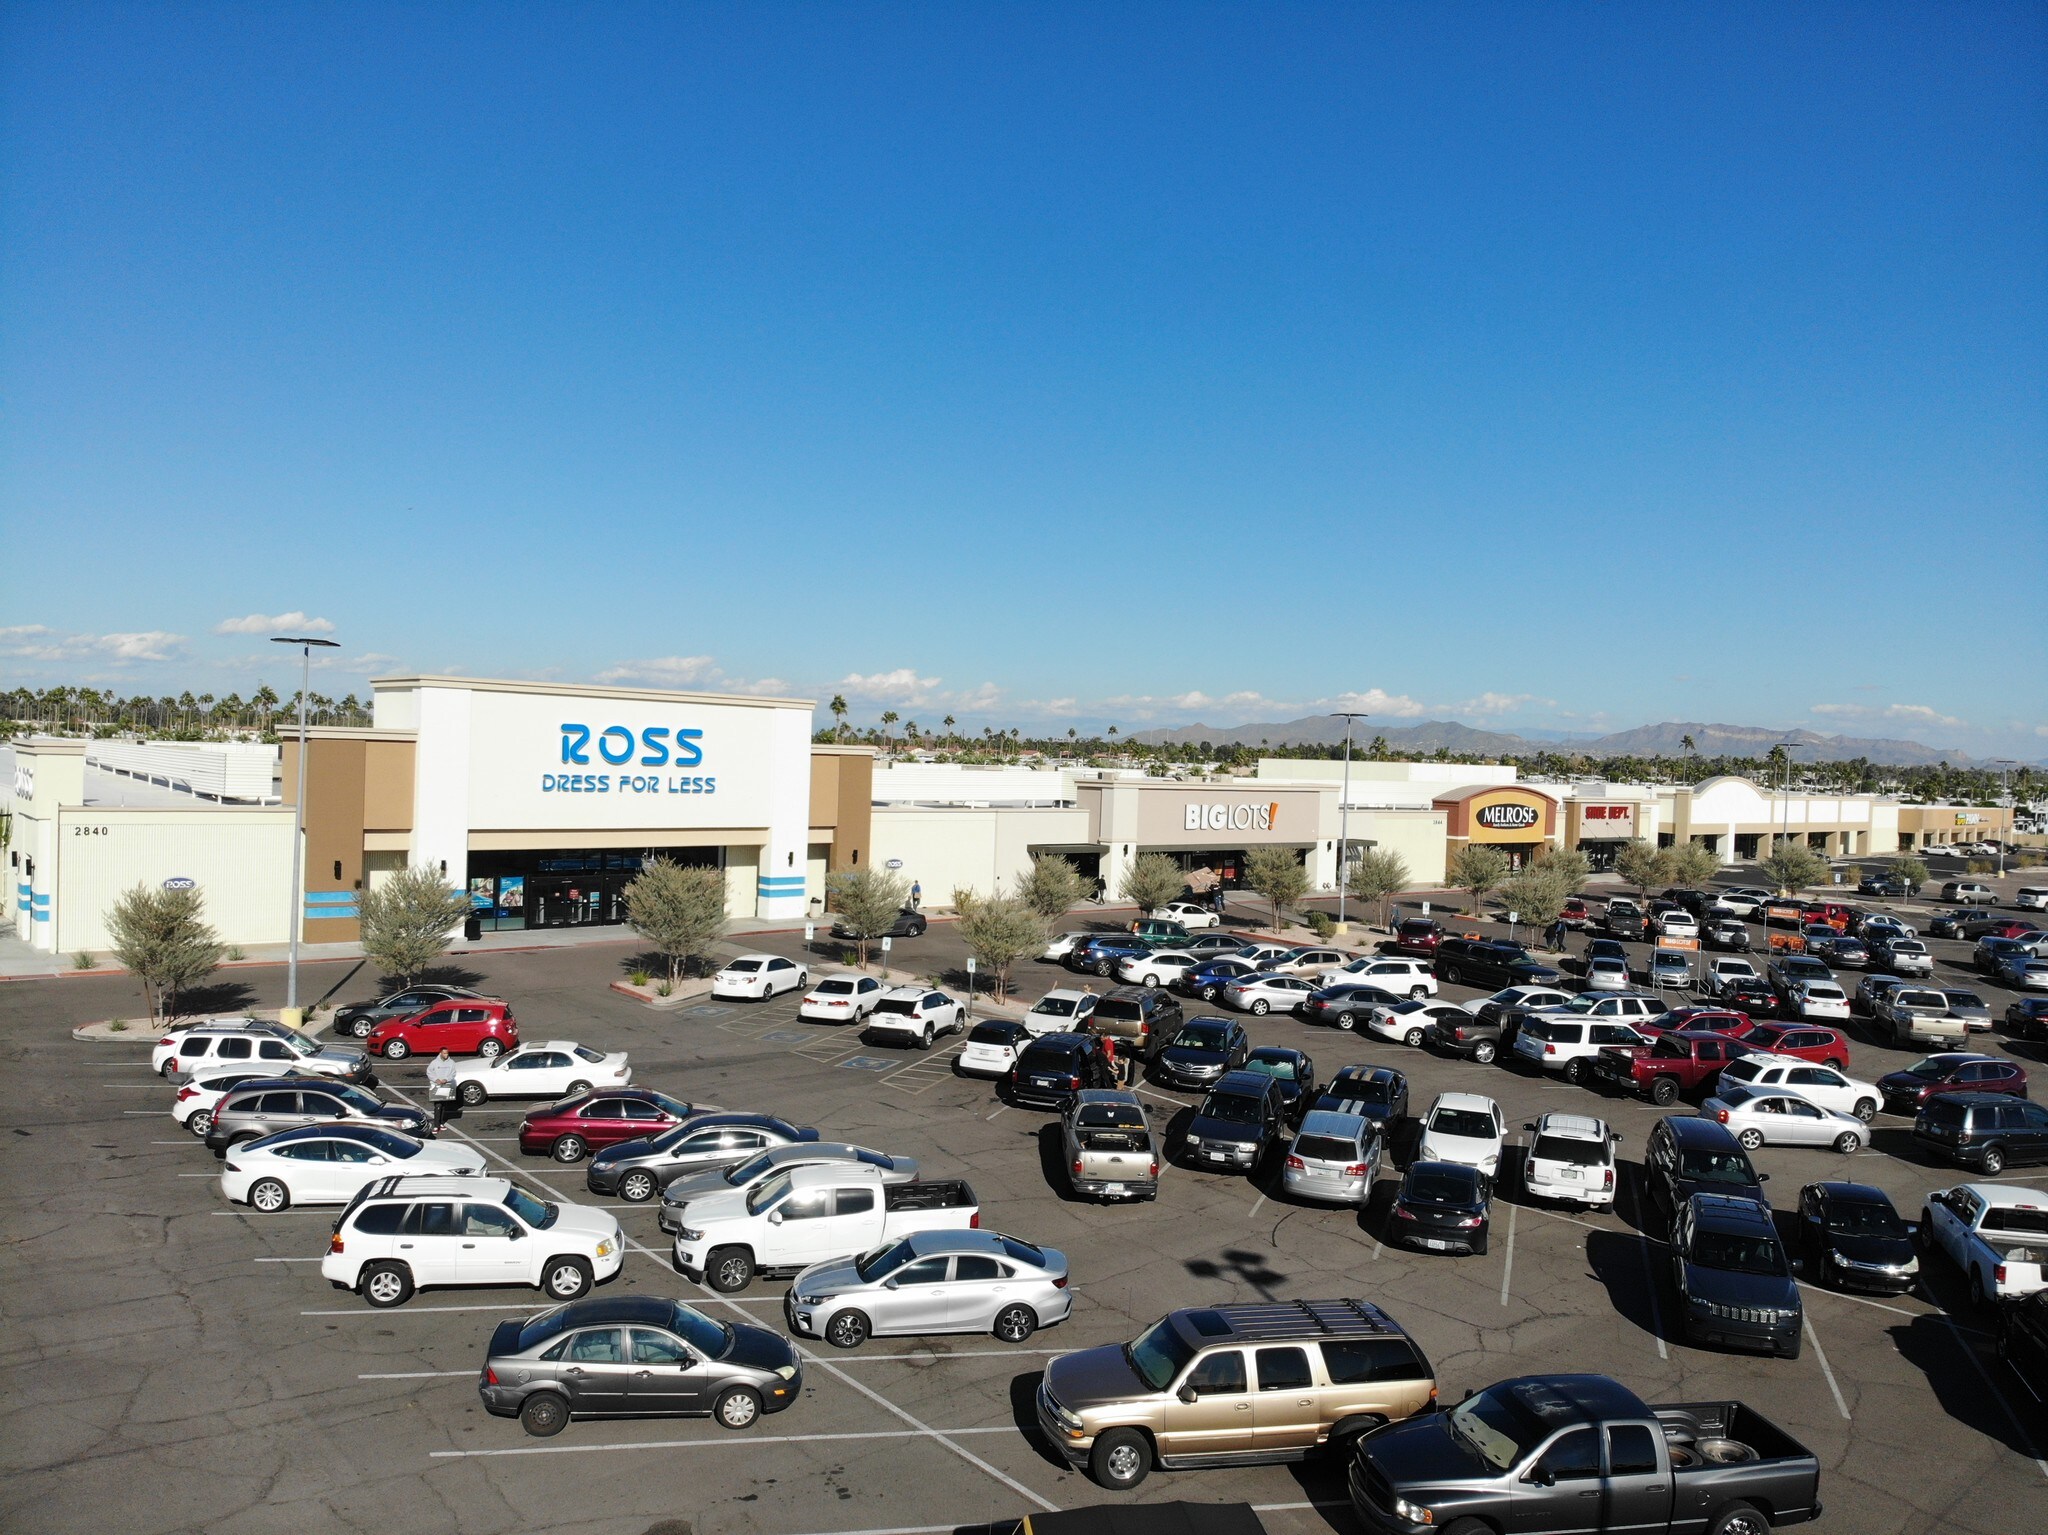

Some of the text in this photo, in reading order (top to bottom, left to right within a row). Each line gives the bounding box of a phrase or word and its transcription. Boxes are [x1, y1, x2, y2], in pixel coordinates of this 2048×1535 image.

[560, 723, 704, 767] ROSS
[542, 774, 716, 794] DRESS FOR LESS
[1484, 806, 1534, 824] MELROSE
[75, 827, 108, 836] 2840
[166, 880, 193, 889] ROSS
